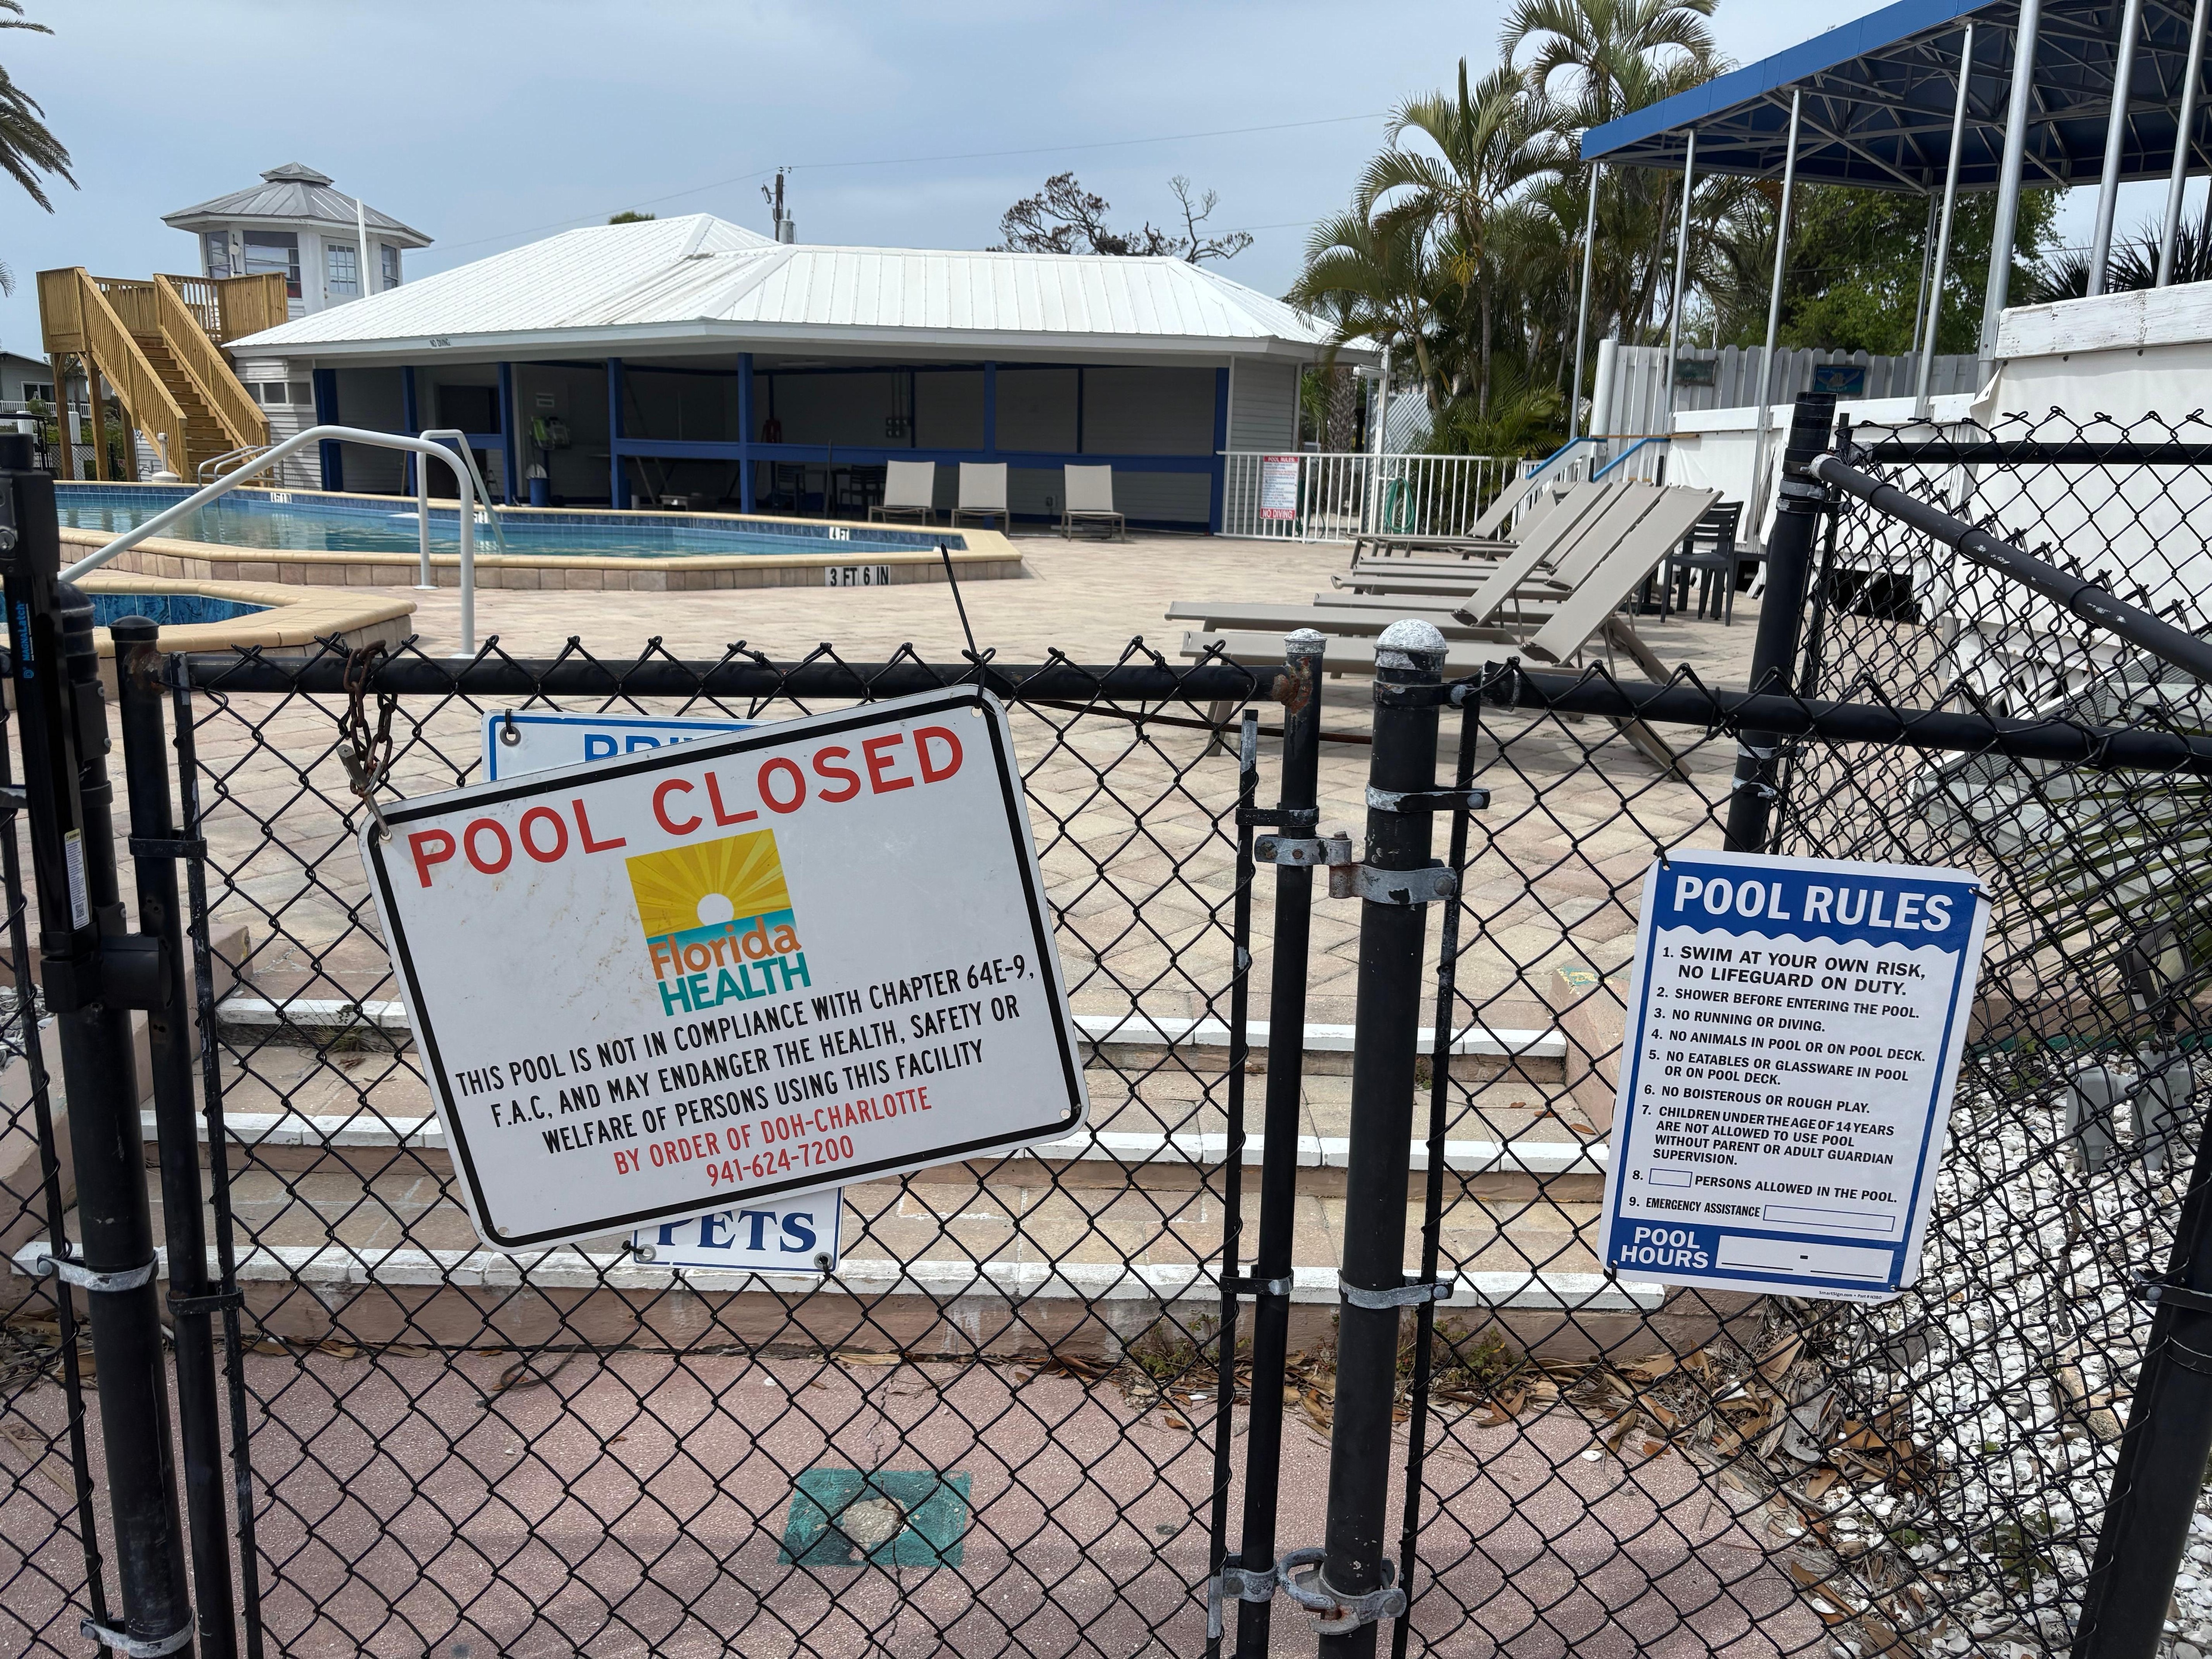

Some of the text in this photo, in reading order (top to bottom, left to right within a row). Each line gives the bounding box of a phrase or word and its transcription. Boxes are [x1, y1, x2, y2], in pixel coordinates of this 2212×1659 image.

[1262, 509, 1292, 519] NO DIVING
[840, 528, 848, 540] FT
[830, 566, 889, 587] 3 FT 6 IN
[408, 726, 963, 887] POOL CLOSED
[1674, 876, 1953, 932] POOL RULES
[648, 917, 802, 980] Florida
[1663, 946, 1925, 980] 1. SWIM AT YOUR OWN RISK,
[658, 952, 811, 1017] HEALTH
[1678, 964, 1906, 995] NO LIFEGUARD ON DUTY.
[1656, 987, 1919, 1018] 2. SHOWER BEFORE ENTERING THE POOL.
[455, 955, 1033, 1096] THIS POOL IS NOT IN COMPLIANCE WITH CHAPTER 64E-9,
[1654, 1008, 1825, 1032] 3. NO RUNNING OR DIVING.
[560, 1084, 600, 1114] AND
[607, 1072, 649, 1103] MAY
[658, 1048, 770, 1093] ENDANGER
[773, 1038, 814, 1068] THE
[819, 1020, 905, 1058] HEALTH,
[910, 1001, 981, 1038] SAFETY
[991, 995, 1020, 1022] OR
[1651, 1029, 1925, 1061] 4. NO ANIMALS IN POOL OR ON POOL DECK.
[1648, 1049, 1908, 1081] 5. NO EATABLES OR GLASSWARE IN POOL
[1665, 1065, 1780, 1085] OR ON POOL DECK.
[541, 1039, 982, 1154] WELFARE OF PERSONS USING THIS FACILITY
[1644, 1084, 1870, 1113] 6. NO BOISTEROUS OR ROUGH PLAY.
[614, 1086, 931, 1175] BY ORDER OF DOH-CHARLOTTE
[1642, 1105, 1894, 1136] 7. CHILDREN UNDER THE AGE OF 14 YEARS
[1656, 1121, 1855, 1147] ARE NOT ALLOWED TO USE POOL
[706, 1135, 853, 1186] 941-624-7200
[1653, 1148, 1737, 1165] SUPERVISION.
[1655, 1134, 1893, 1165] WITHOUT PARENT OR ADULT GUARDIAN
[1632, 1170, 1643, 1180] 8.
[1695, 1175, 1897, 1203] PERSONS ALLOWED IN THE POOL.
[1629, 1196, 1761, 1217] 9. EMERGENCY ASSISTANCE
[1634, 1227, 1700, 1249] POOL
[1621, 1245, 1709, 1268] HOURS
